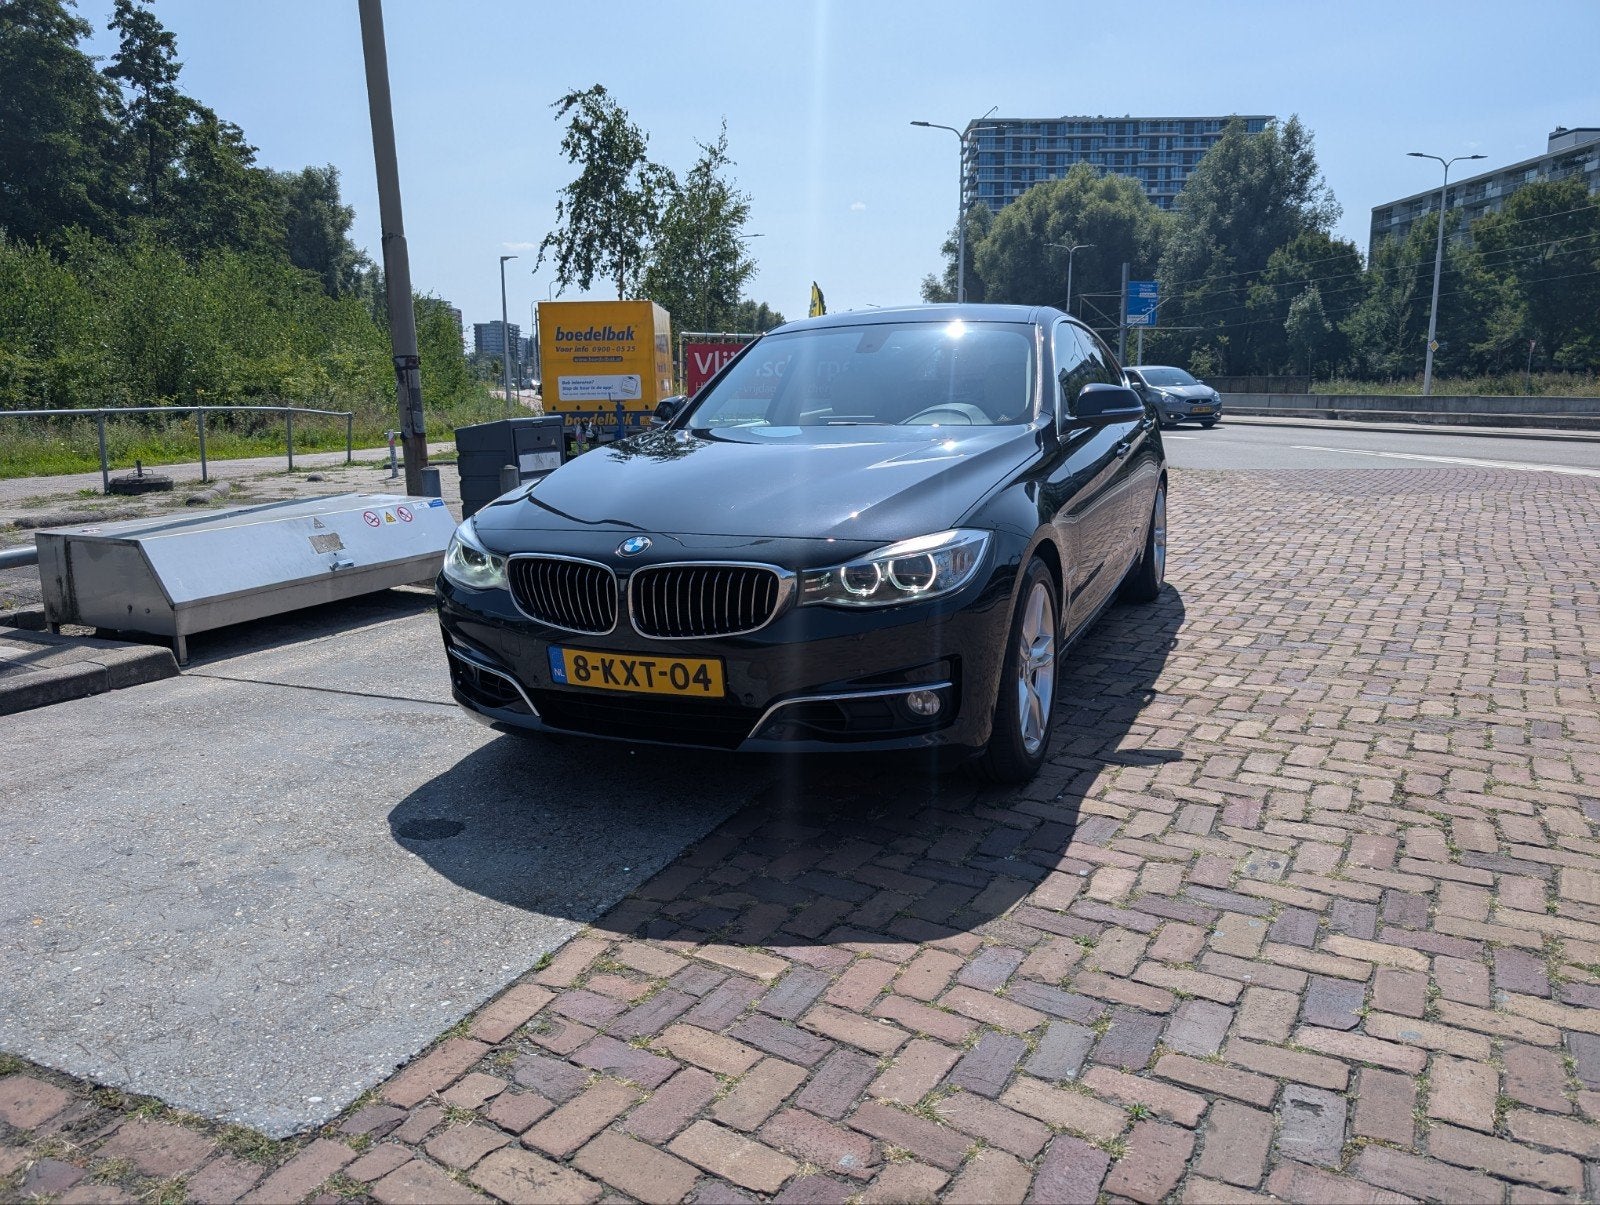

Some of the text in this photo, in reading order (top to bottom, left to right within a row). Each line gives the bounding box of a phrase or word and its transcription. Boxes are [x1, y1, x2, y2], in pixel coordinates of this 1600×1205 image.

[555, 326, 635, 341] boedelbak
[564, 414, 633, 426] boedelbk
[554, 668, 565, 677] NL
[573, 655, 712, 691] 8-KXT-04
